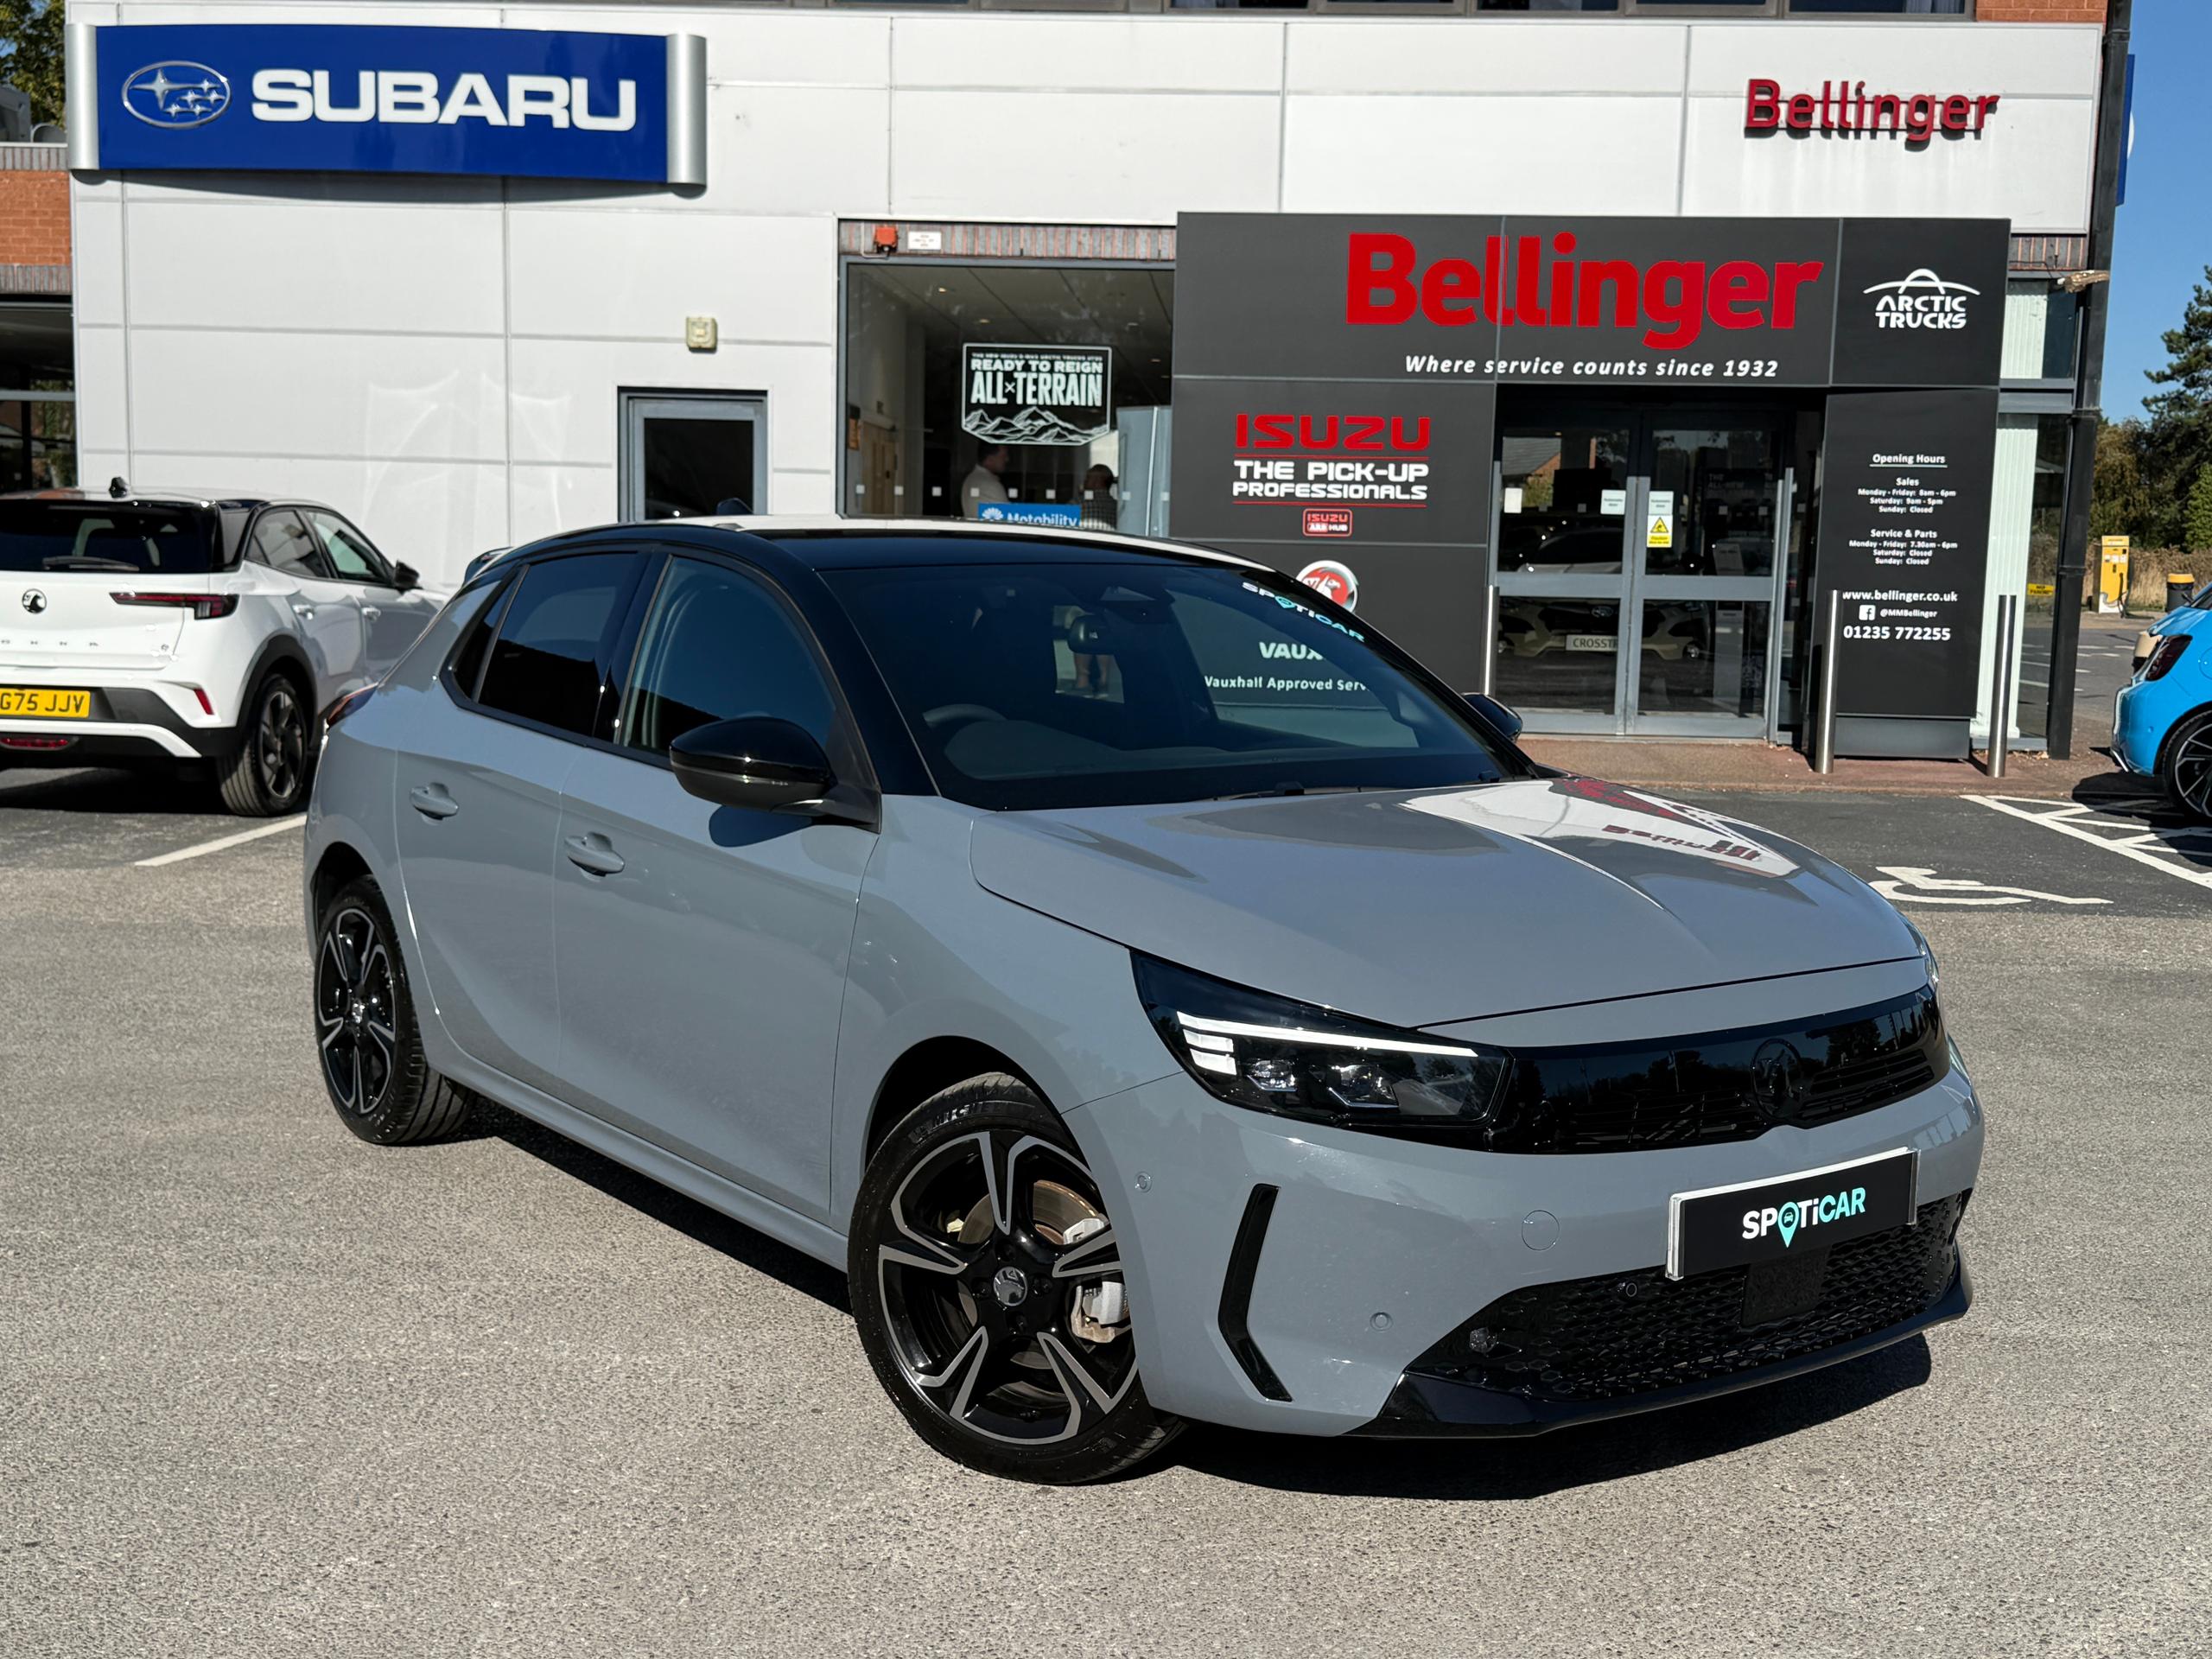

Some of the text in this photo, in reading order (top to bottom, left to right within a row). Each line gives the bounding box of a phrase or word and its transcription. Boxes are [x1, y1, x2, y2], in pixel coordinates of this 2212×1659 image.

[251, 68, 637, 132] SUBARU
[1746, 79, 2000, 141] Bellinger
[1345, 232, 1824, 350] Bellinger
[1875, 296, 1967, 312] ARCTIC
[1875, 312, 1967, 329] TRUCKS
[970, 359, 1103, 373] READY TO REIGN
[1405, 355, 1778, 377] Where service counts since 1932
[1236, 413, 1430, 451] ISUZU
[1872, 454, 1946, 465] Opening Hours
[1233, 460, 1429, 482] THE PICK-UP
[1896, 477, 1920, 486] Sales
[1232, 481, 1428, 500] PROFESSIONALS
[1858, 488, 1886, 497] Monday
[1870, 529, 1937, 538] Service & Parts
[1842, 590, 1958, 603] www.bellinger.co.uk
[1880, 609, 1937, 618] @MMBellinger
[1843, 626, 1951, 641] 01235 772255
[1205, 676, 1262, 688] Vauxhall
[1267, 677, 1332, 690] Approved
[45, 695, 85, 713] JJV
